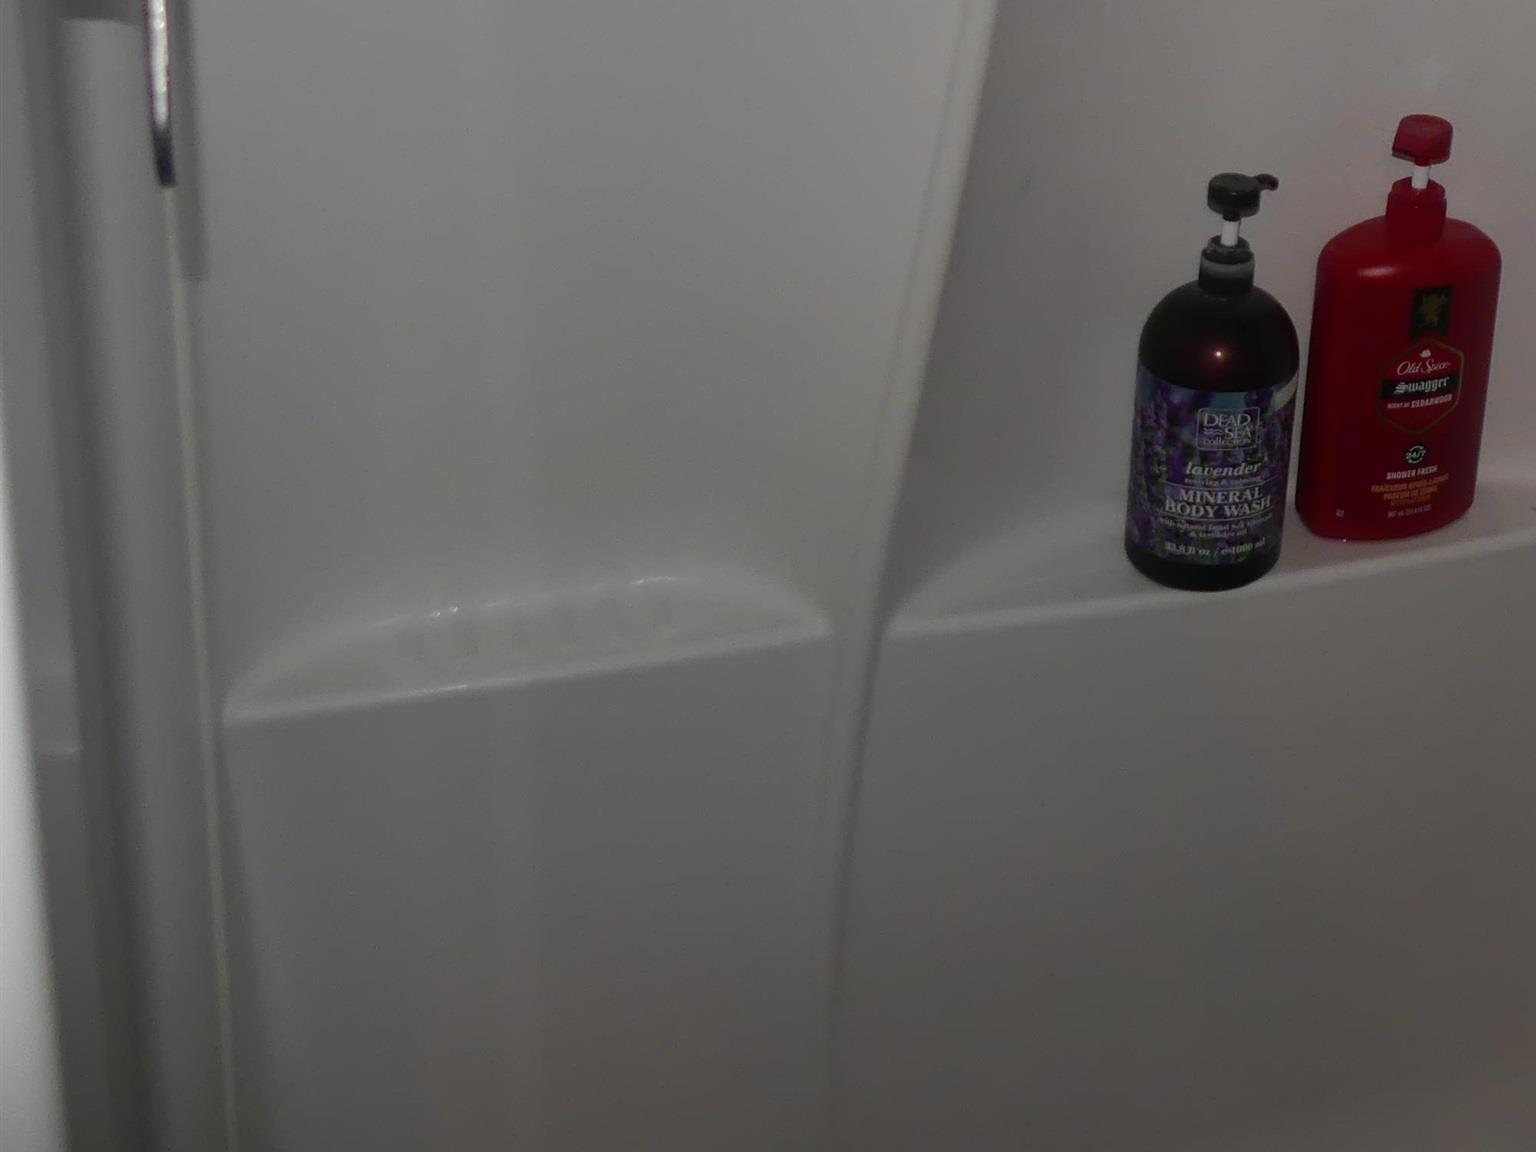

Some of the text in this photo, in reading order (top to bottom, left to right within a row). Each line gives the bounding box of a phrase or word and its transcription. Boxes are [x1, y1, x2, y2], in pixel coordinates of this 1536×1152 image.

[1397, 360, 1422, 375] Old
[1393, 376, 1450, 395] Swagger
[1204, 412, 1251, 427] DEAD
[1225, 426, 1251, 439] SEA
[1185, 462, 1261, 477] lavender
[1179, 487, 1263, 504] MINERAL
[1165, 496, 1271, 517] BODY WASH
